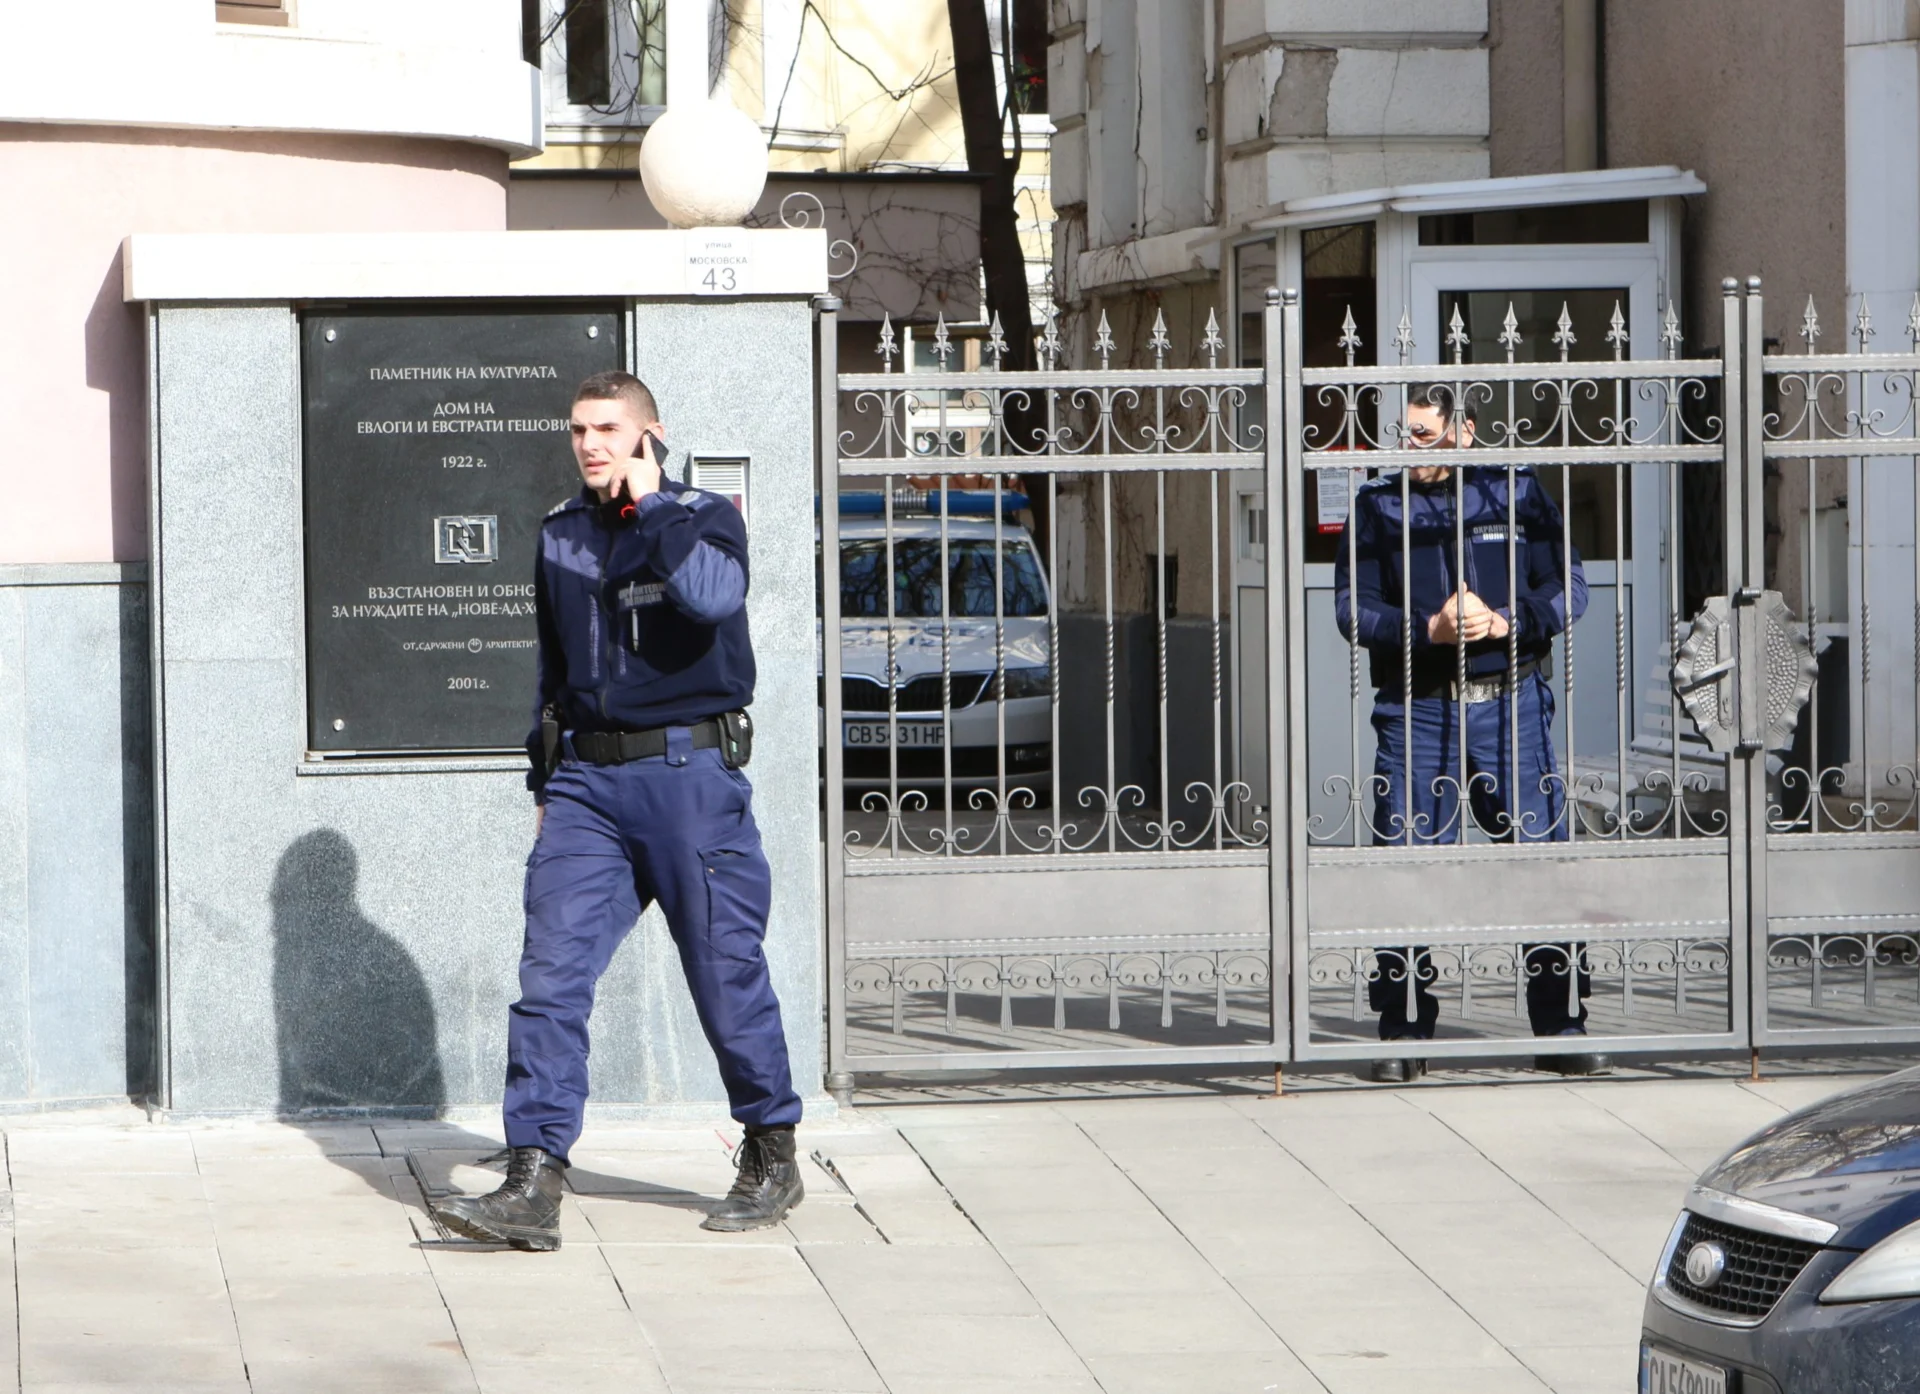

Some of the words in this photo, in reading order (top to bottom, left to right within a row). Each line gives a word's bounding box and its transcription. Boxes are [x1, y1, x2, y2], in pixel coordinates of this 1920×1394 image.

[705, 242, 732, 250] улица
[689, 257, 748, 265] МОСКОВСКА
[702, 267, 737, 291] 43
[370, 367, 452, 381] ПАМЕТНИК
[456, 367, 476, 380] НА
[480, 366, 557, 380] КУЛТУРАТА
[434, 402, 470, 417] ДОМ
[474, 402, 495, 415] НА
[358, 421, 412, 434] ЕВЛОГИ
[417, 421, 428, 433] И
[432, 420, 503, 433] ЕВСТРАТИ
[508, 419, 571, 432] ГЕШОВИ
[441, 456, 473, 469] 1922
[369, 586, 473, 599] ВЪЗСТАНОВЕН
[478, 585, 488, 597] И
[332, 606, 349, 618] ЗА
[353, 604, 424, 618] НУЖДИТЕ
[428, 604, 448, 616] НА
